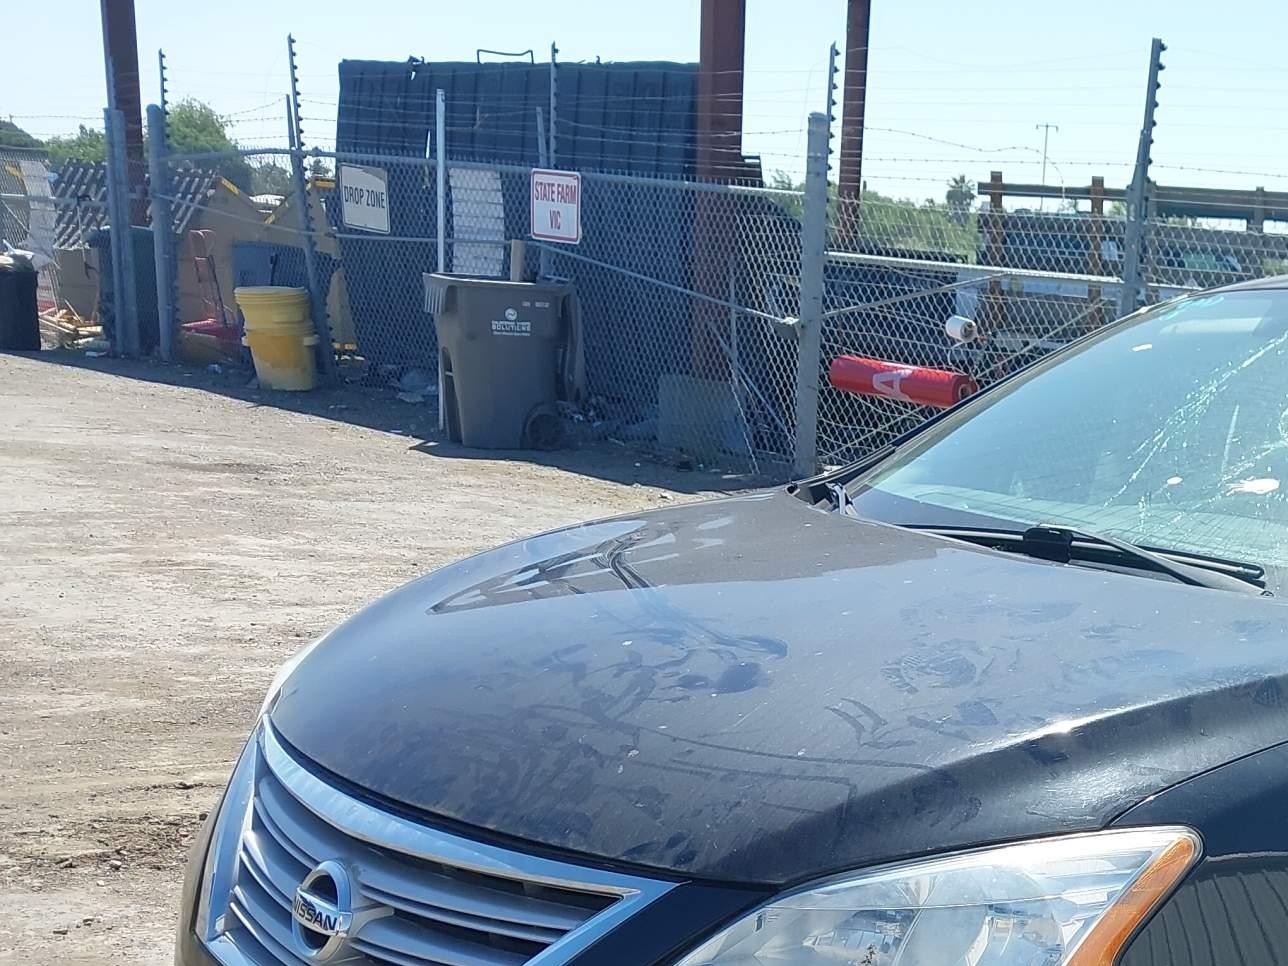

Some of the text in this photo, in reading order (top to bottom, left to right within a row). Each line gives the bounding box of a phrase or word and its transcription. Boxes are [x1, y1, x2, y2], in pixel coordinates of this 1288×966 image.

[344, 185, 385, 208] DROP ZONE
[535, 181, 576, 204] STATE FARM
[550, 209, 561, 230] VIC
[294, 894, 338, 931] NISSAN
